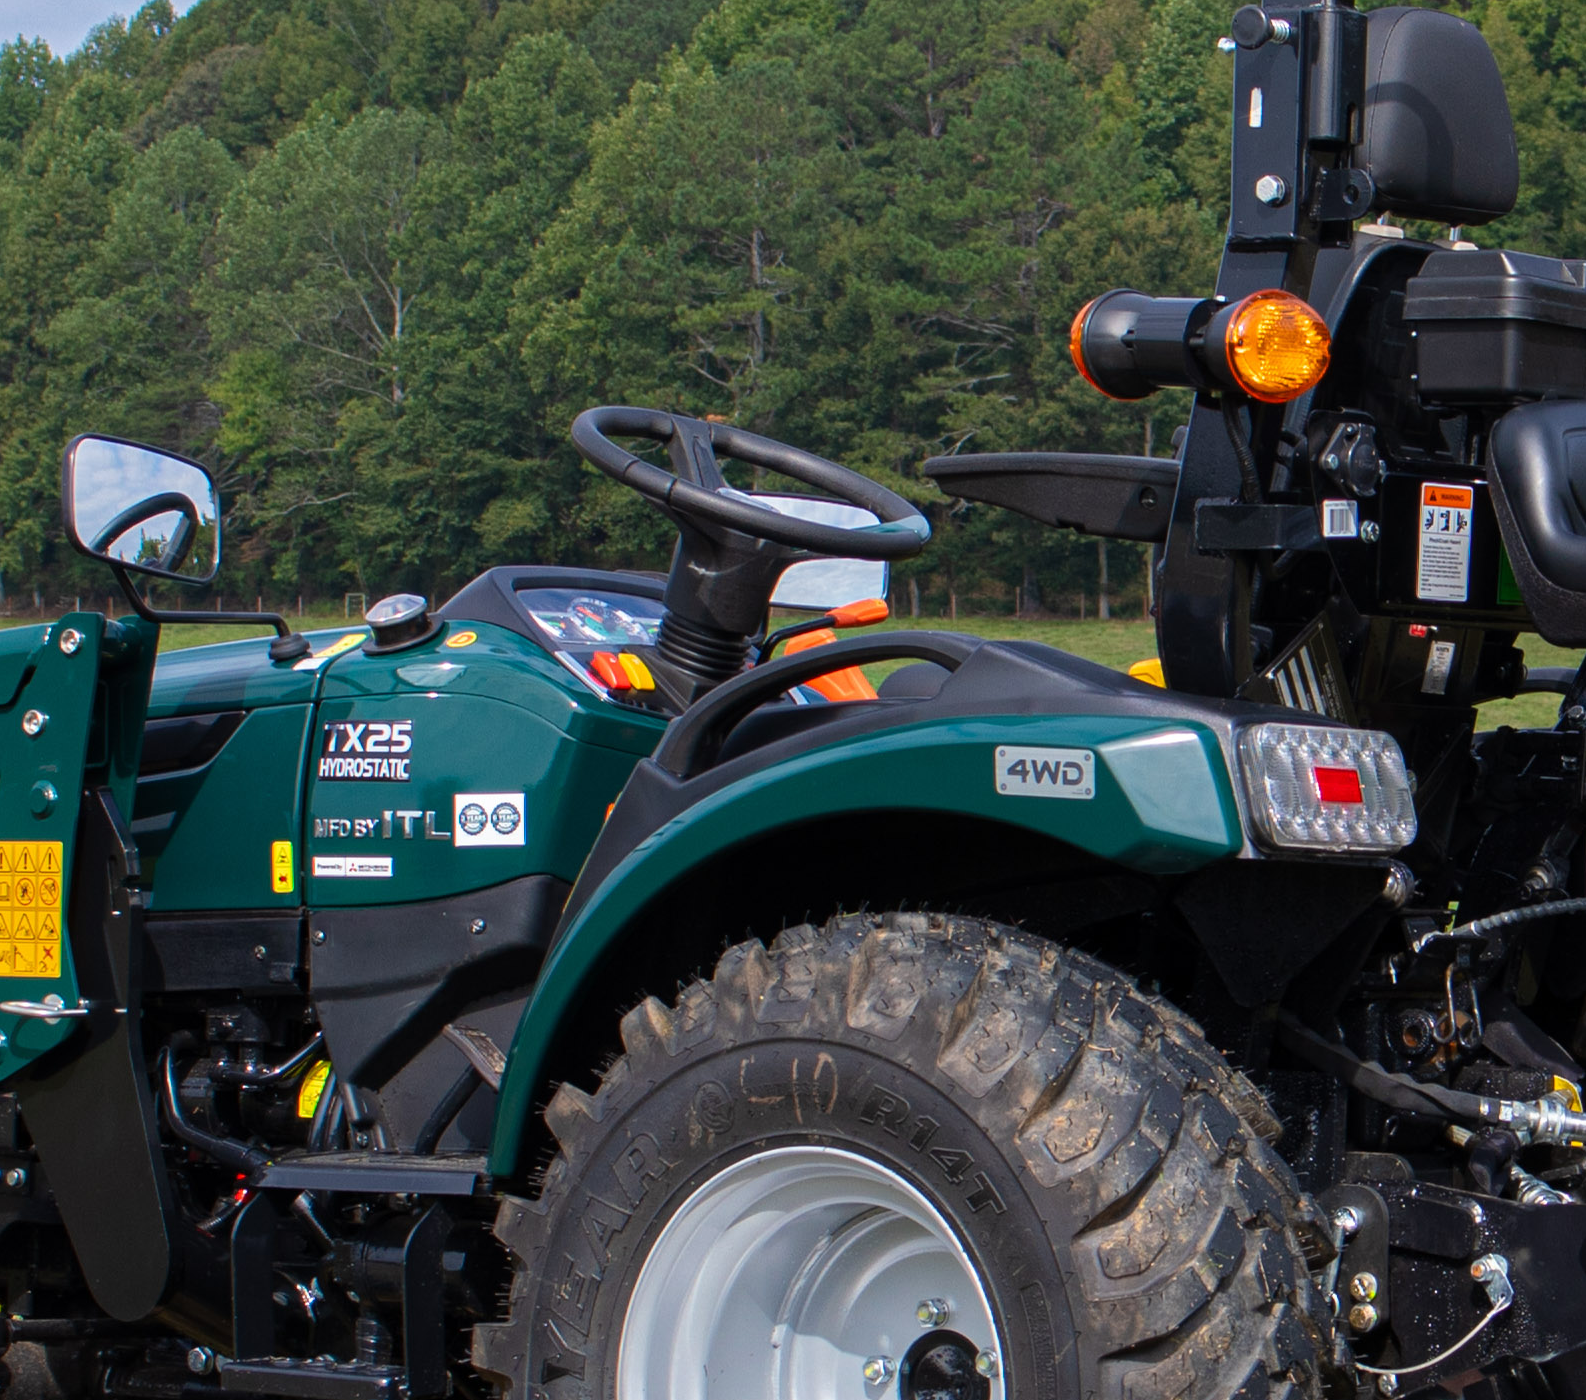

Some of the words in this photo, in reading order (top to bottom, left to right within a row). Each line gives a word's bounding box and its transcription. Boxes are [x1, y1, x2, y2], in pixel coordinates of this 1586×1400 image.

[1440, 493, 1465, 502] WARNING
[324, 723, 412, 752] TX25
[319, 758, 410, 779] HYDROSTATIC
[1007, 759, 1084, 786] 4WD
[314, 818, 351, 838] MFD
[354, 818, 379, 838] BY
[382, 810, 451, 840] ITL
[858, 1084, 1007, 1216] R14T
